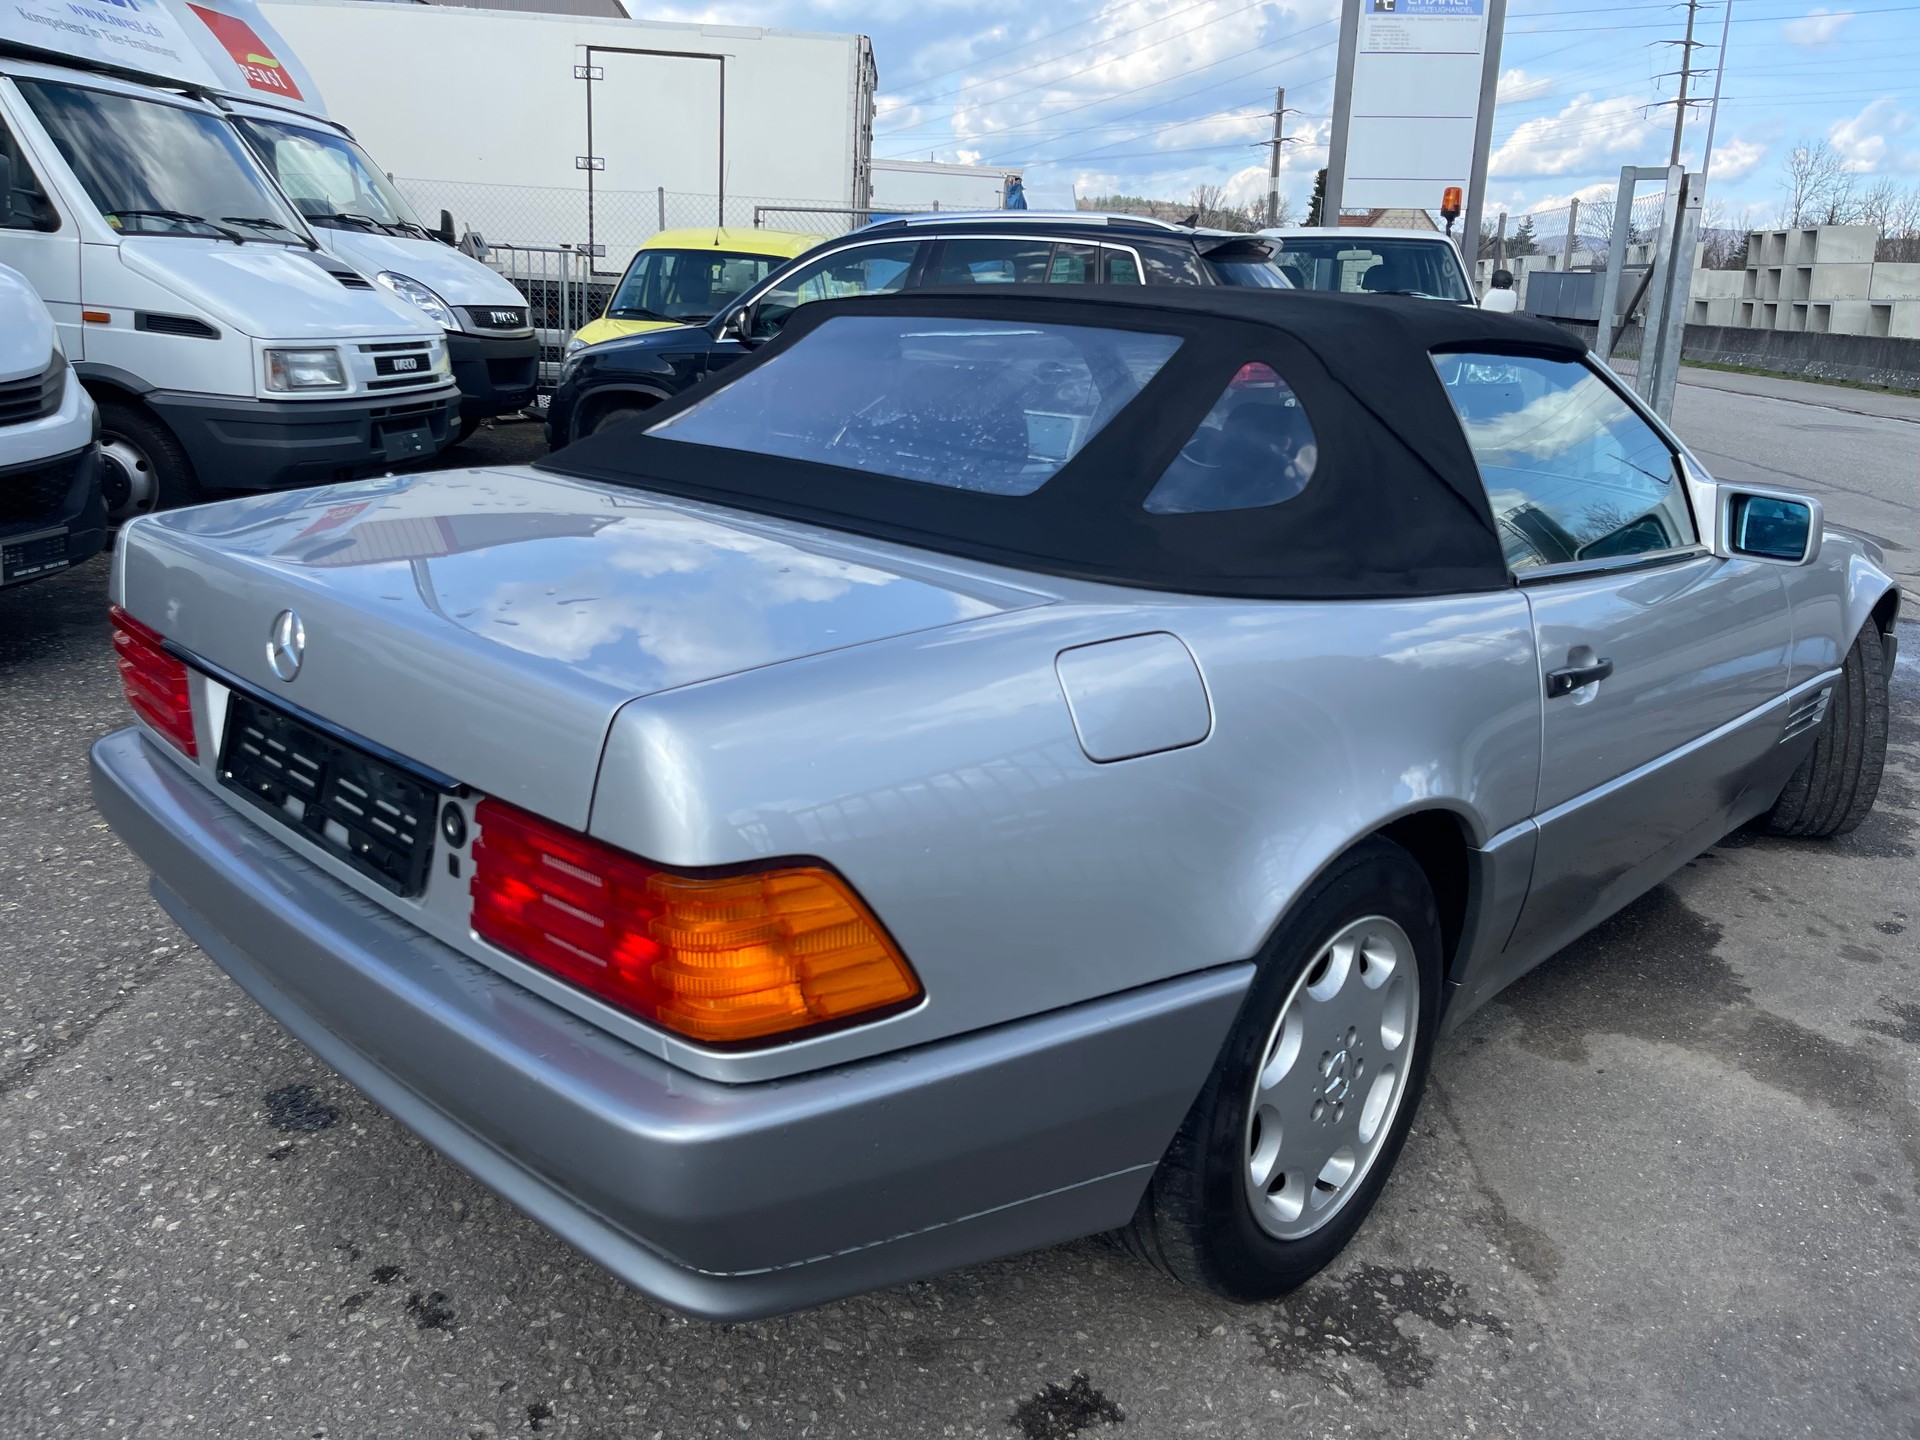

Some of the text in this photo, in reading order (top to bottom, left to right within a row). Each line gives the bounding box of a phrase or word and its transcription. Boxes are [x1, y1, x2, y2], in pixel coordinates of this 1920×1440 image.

[1406, 6, 1474, 14] FAHRZEUGHANDEL
[15, 5, 90, 36] Kompetenz
[84, 24, 104, 40] in
[490, 311, 519, 324] IVECO
[393, 357, 418, 371] IVECO
